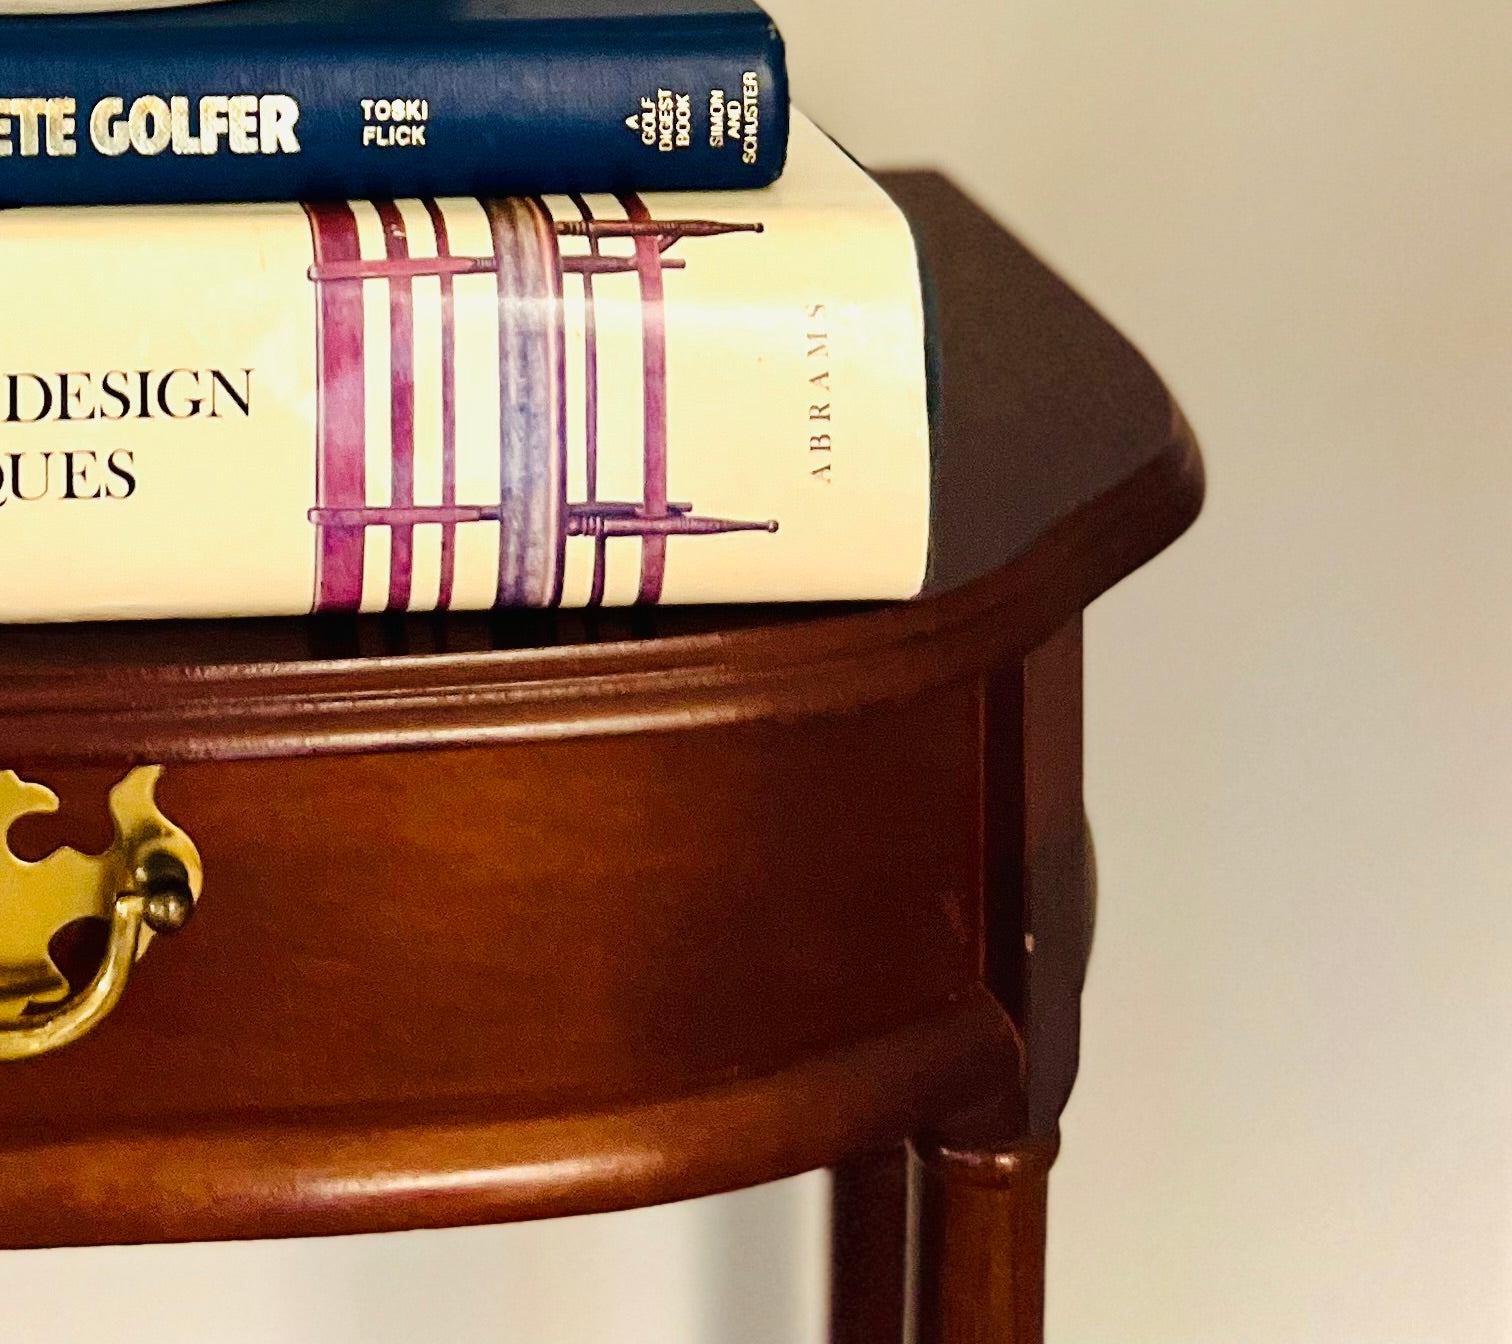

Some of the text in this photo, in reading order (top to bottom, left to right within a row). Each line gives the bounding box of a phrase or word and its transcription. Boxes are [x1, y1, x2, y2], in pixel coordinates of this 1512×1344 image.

[89, 94, 301, 155] GOLFER
[360, 99, 428, 121] TOSKI
[362, 125, 426, 146] FLICK
[625, 114, 639, 130] A
[641, 97, 656, 145] GOLF
[658, 88, 673, 151] DIGEST
[675, 93, 690, 146] BOOK
[709, 89, 724, 147] SIMON
[727, 100, 741, 139] AND
[742, 71, 759, 164] SCHUSTER
[3, 368, 255, 424] DESIGN
[807, 303, 832, 484] ABRAMS
